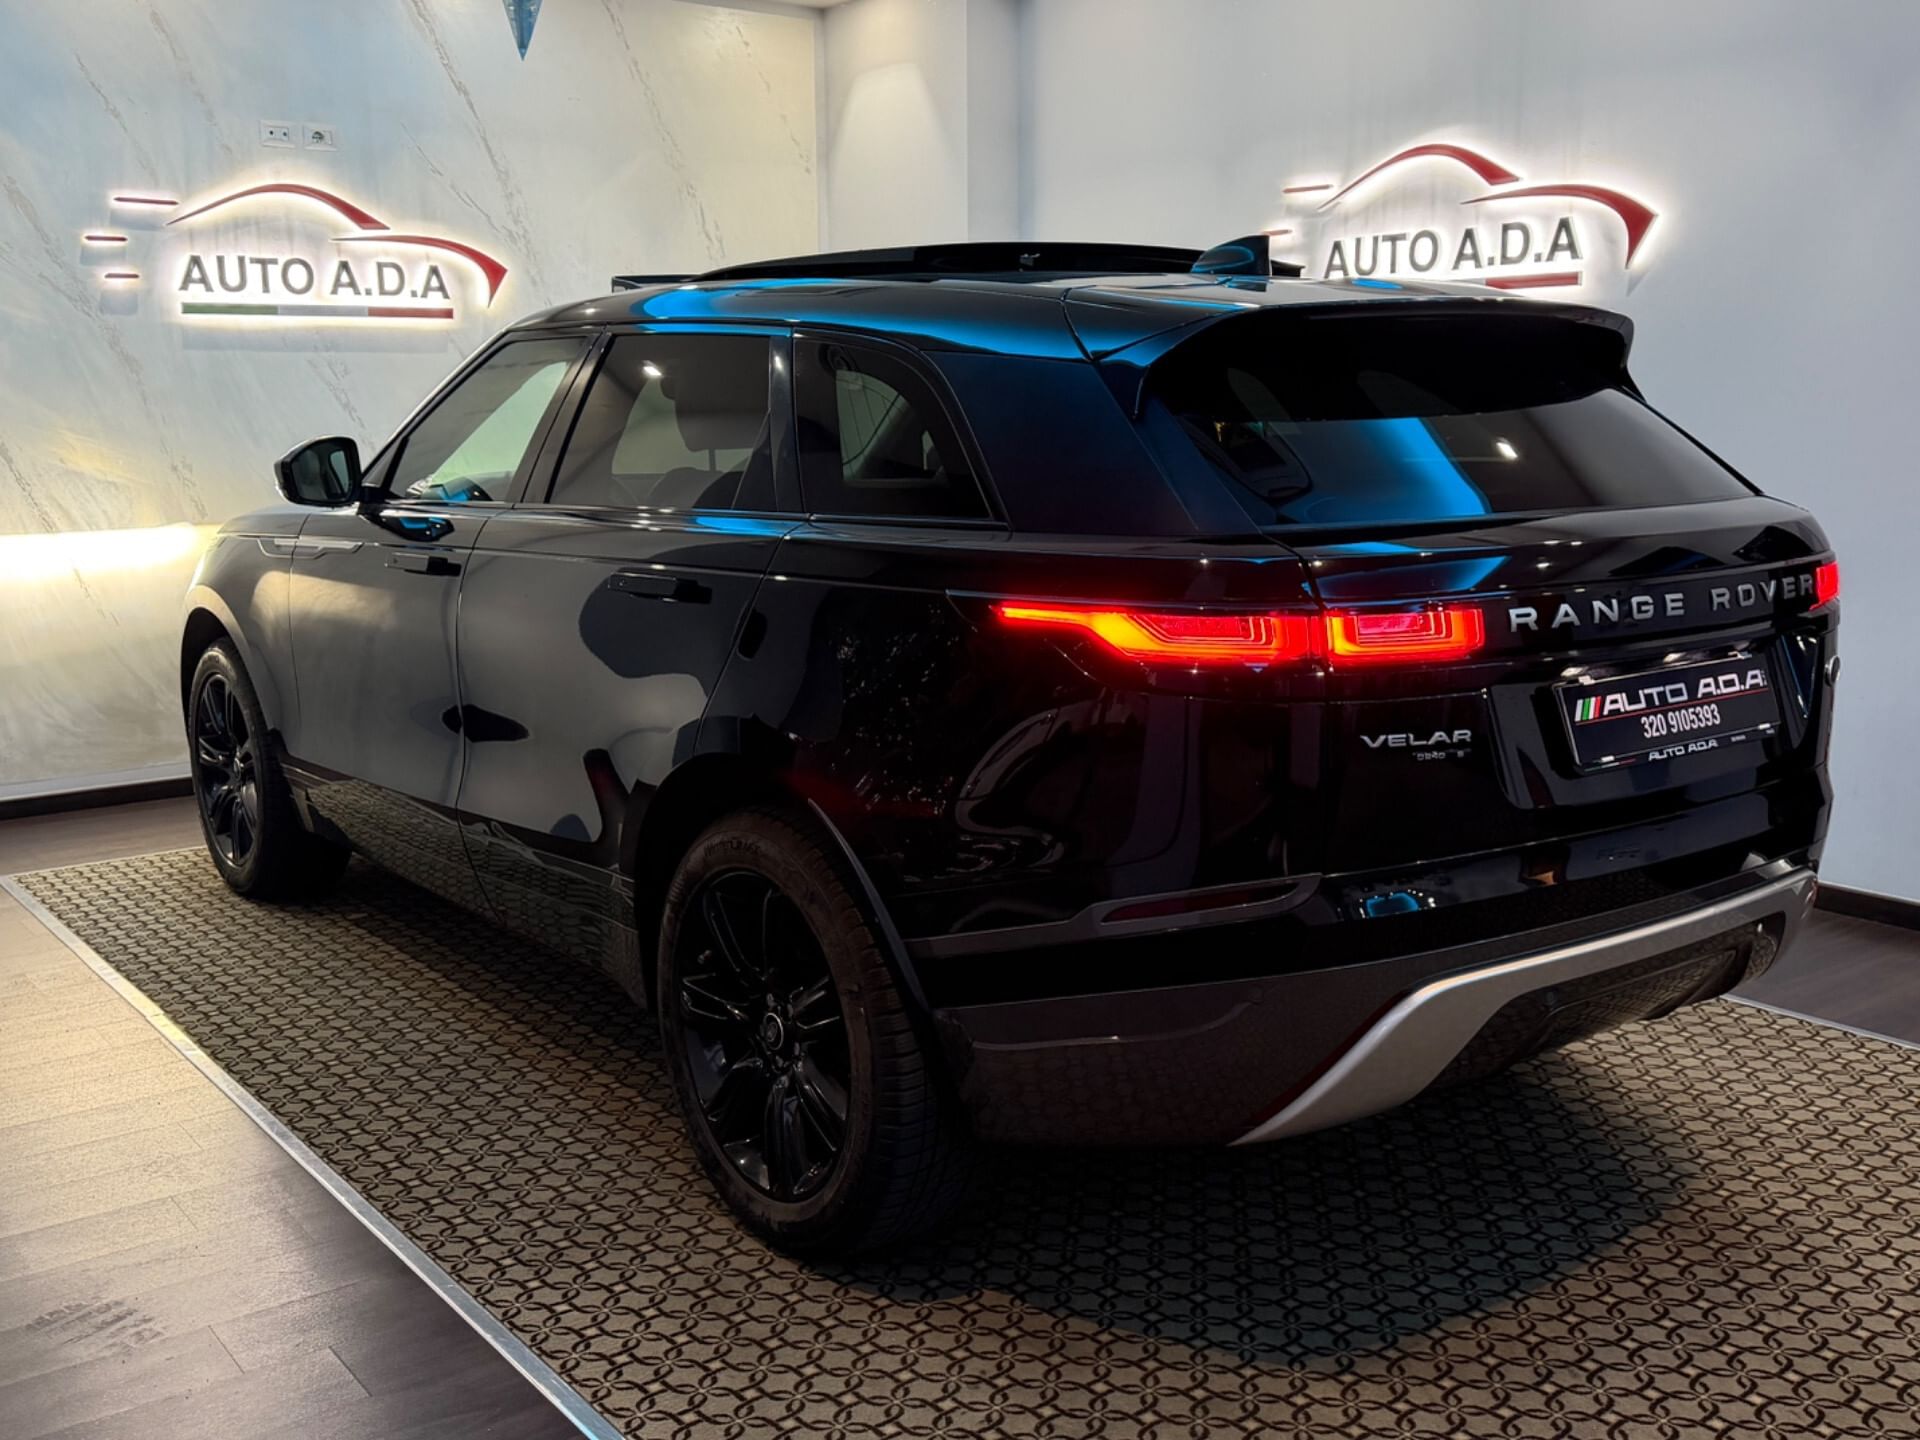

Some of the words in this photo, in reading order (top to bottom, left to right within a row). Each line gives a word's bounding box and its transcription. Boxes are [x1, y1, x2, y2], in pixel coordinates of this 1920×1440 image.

[1323, 228, 1439, 279] AUTO
[1452, 216, 1582, 271] A.D.A
[178, 254, 315, 296] AUTO
[329, 260, 451, 300] A.D.A
[1508, 592, 1686, 632] RANGE
[1710, 573, 1813, 612] ROVER
[1602, 682, 1689, 716] AUTO
[1359, 729, 1472, 748] VELAR
[1640, 714, 1668, 739] 320
[1668, 703, 1721, 734] 9105393
[1648, 745, 1686, 761] AUTO
